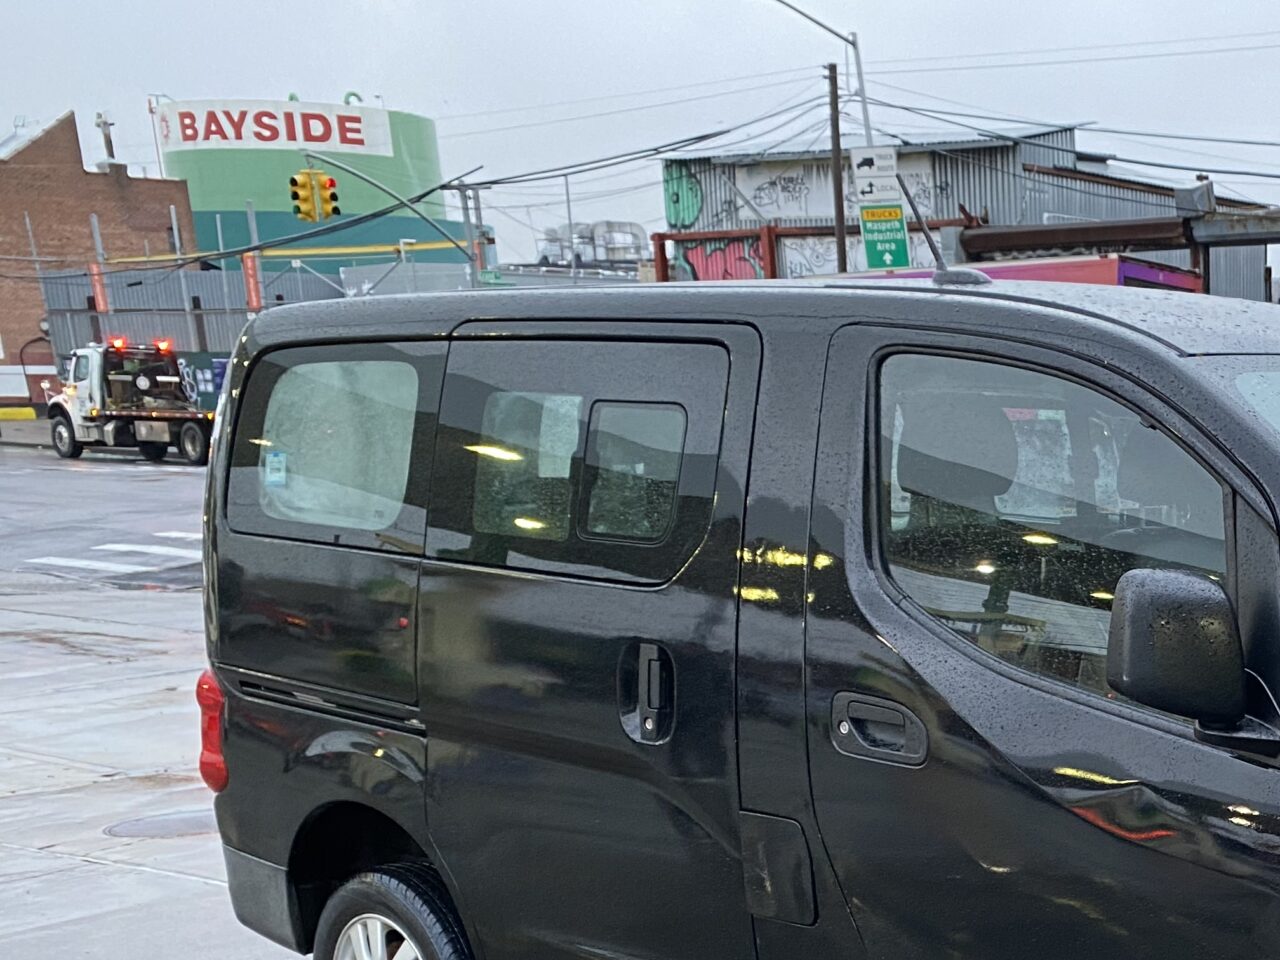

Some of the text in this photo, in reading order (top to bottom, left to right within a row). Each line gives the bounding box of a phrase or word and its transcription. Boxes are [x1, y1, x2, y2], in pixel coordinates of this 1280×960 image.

[178, 110, 365, 146] BAYSIDE
[864, 210, 899, 218] TRUCKS
[866, 221, 900, 231] Maspeth
[864, 230, 904, 241] Industrial
[876, 242, 896, 250] Area
